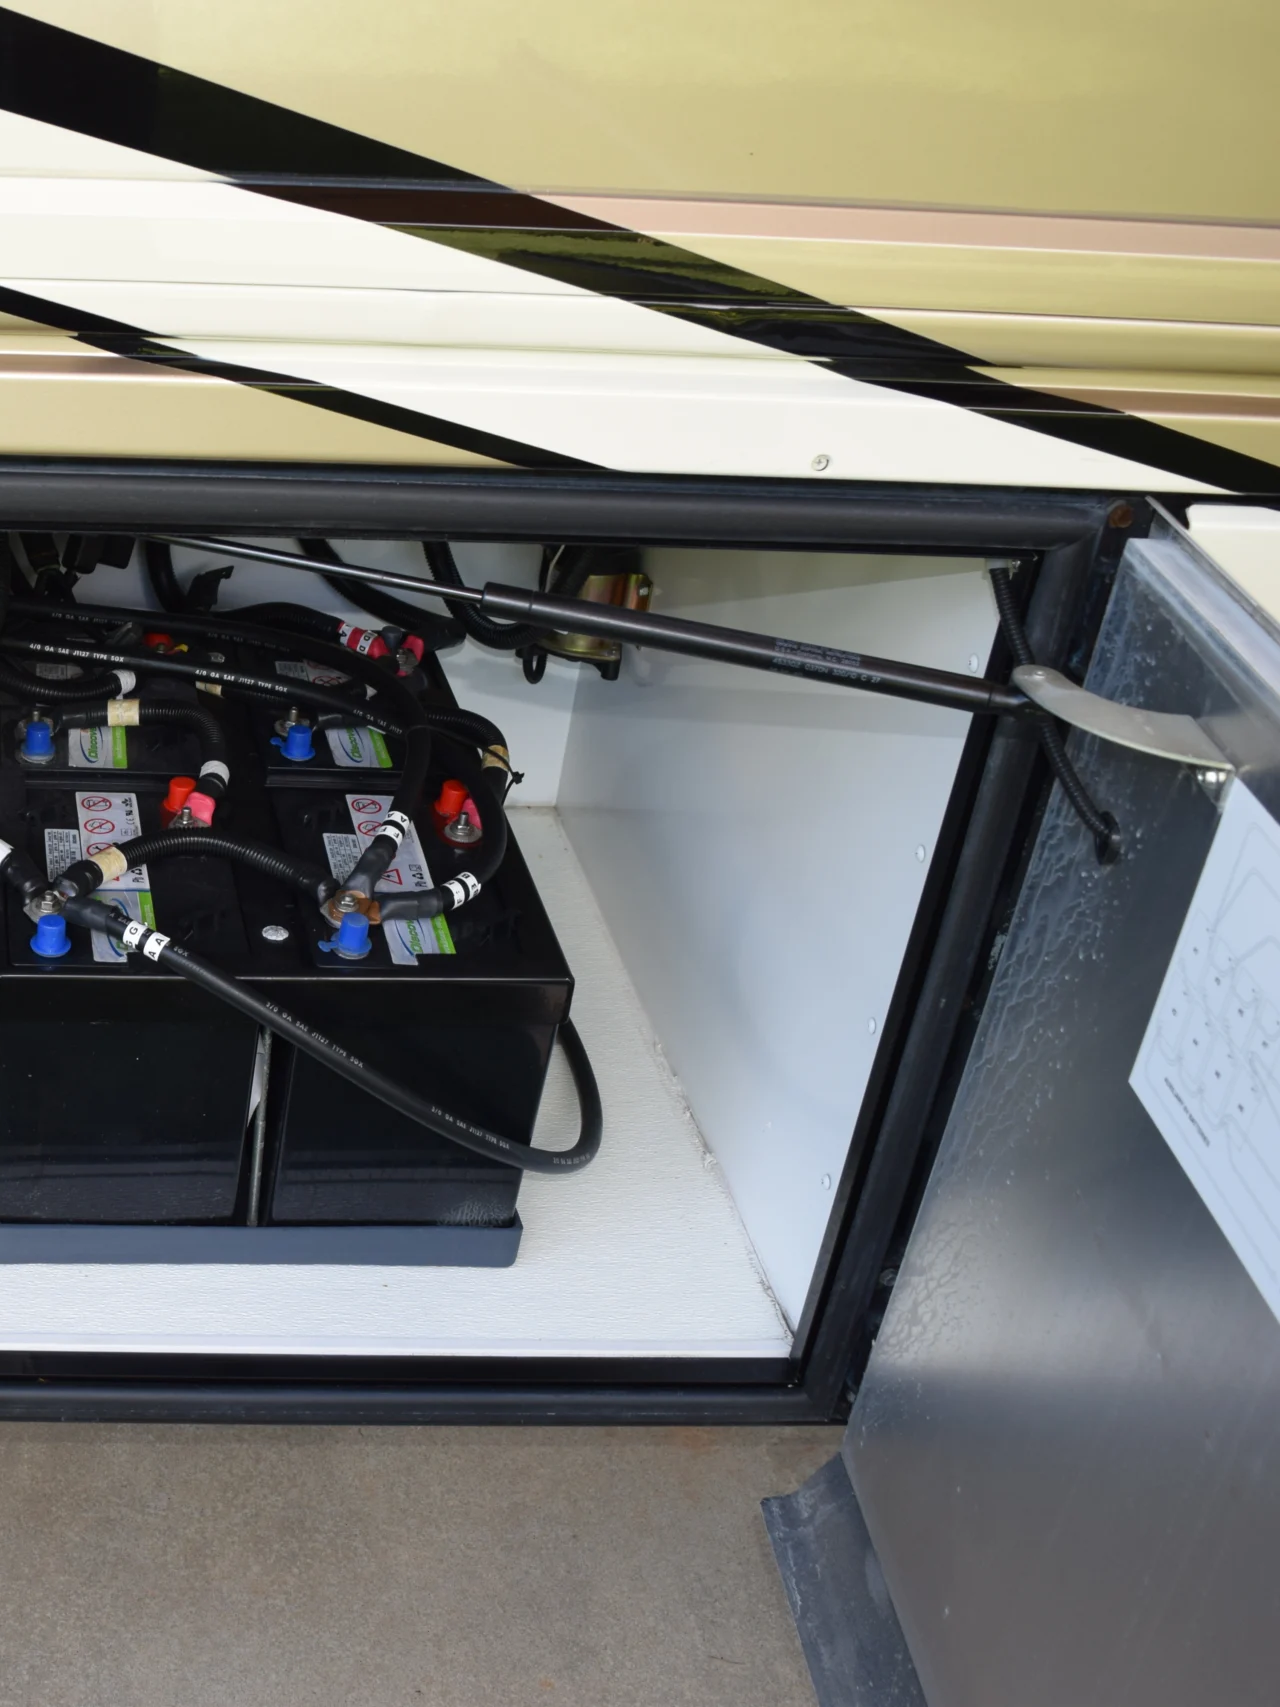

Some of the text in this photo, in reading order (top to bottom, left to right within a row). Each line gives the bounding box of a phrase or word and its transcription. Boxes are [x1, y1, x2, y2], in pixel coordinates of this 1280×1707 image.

[44, 645, 54, 653] GA
[58, 647, 70, 655] SAE
[72, 649, 89, 658] J1127
[93, 652, 108, 661] TYPE
[110, 654, 125, 663] SGX
[210, 671, 220, 679] GA
[223, 674, 235, 683] SAE
[238, 676, 254, 685] J1127
[258, 681, 272, 690] TYPE
[275, 684, 288, 693] SGX
[129, 926, 139, 935] G
[155, 937, 165, 946] A
[148, 951, 157, 959] A
[282, 1012, 292, 1022] GA
[295, 1021, 309, 1032] SAE
[311, 1032, 329, 1045] J1127
[332, 1044, 347, 1057] TYPE
[469, 1125, 483, 1137] J1127
